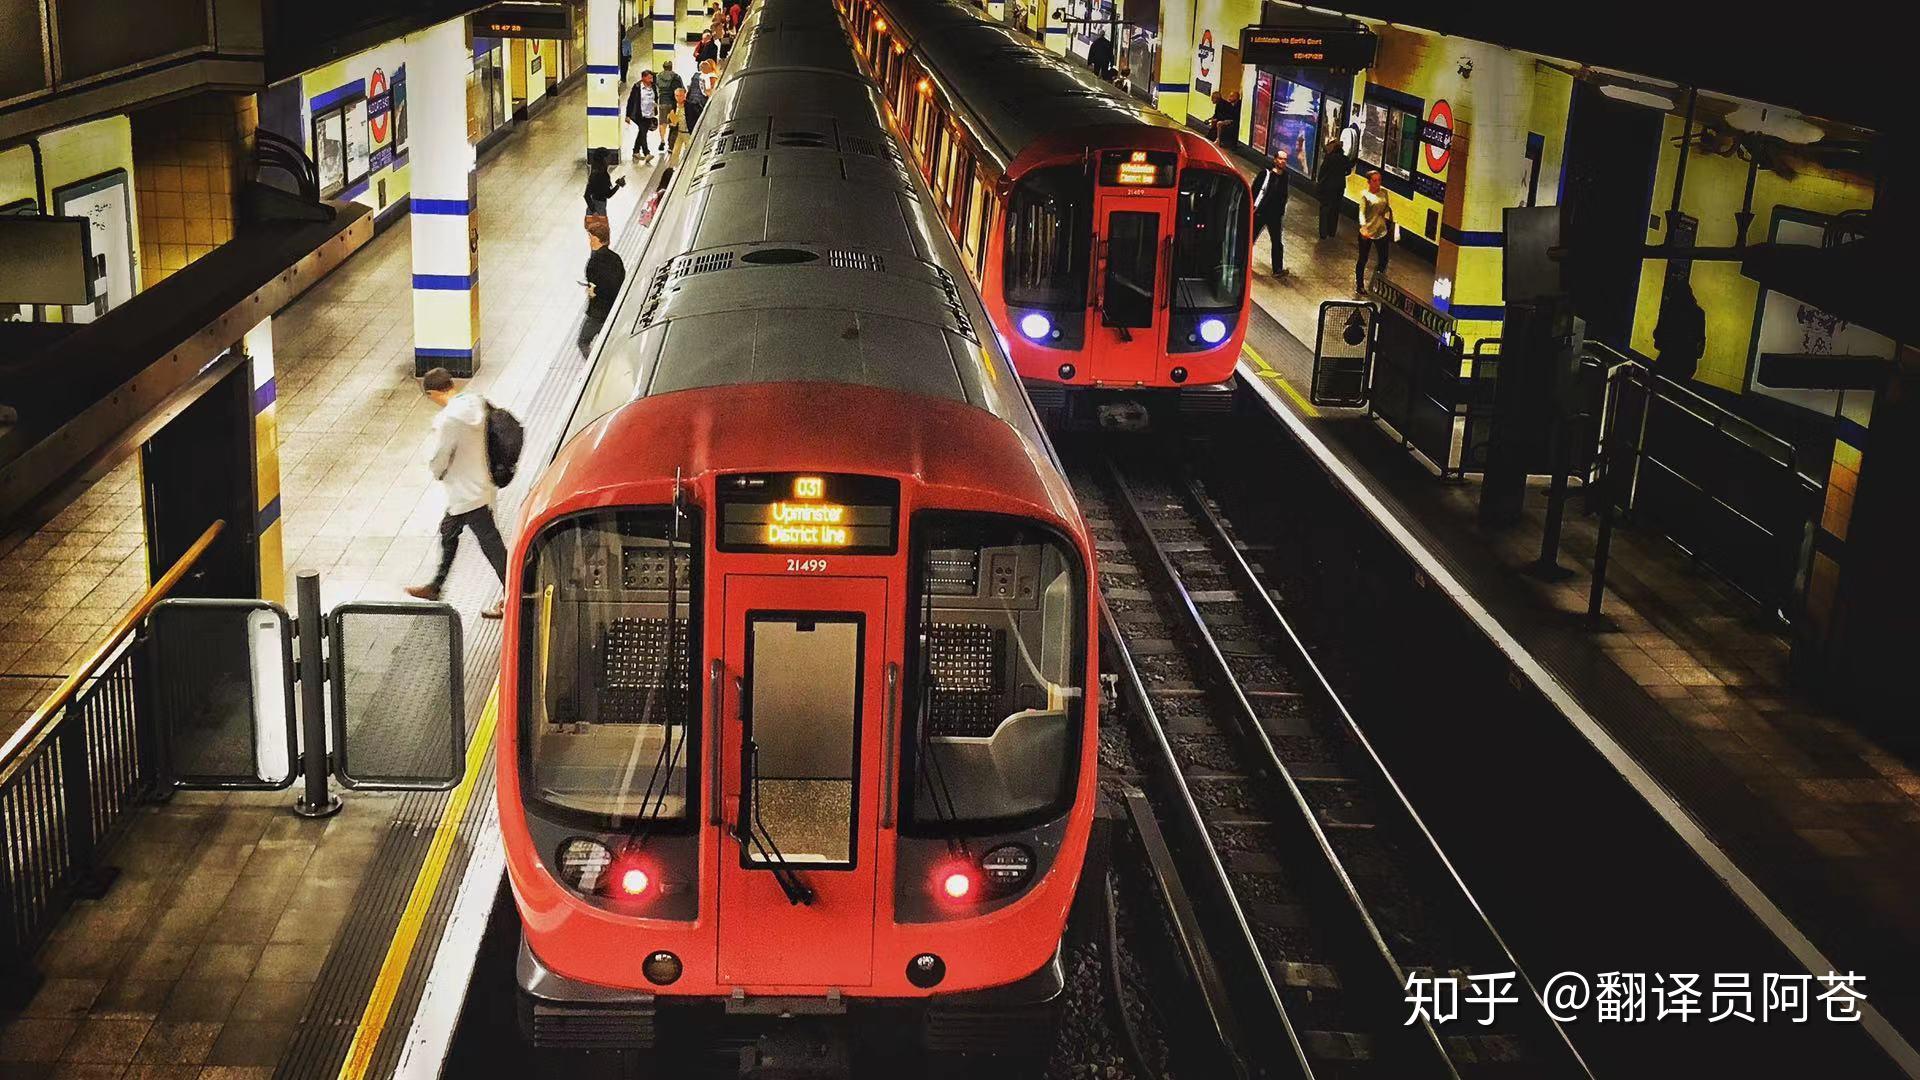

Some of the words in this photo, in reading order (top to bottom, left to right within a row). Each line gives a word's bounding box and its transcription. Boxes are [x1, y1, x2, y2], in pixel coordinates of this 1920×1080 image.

[798, 478, 823, 497] 031
[772, 503, 844, 523] Upminster
[768, 525, 819, 543] District
[821, 525, 846, 544] line
[787, 558, 828, 572] 21499
